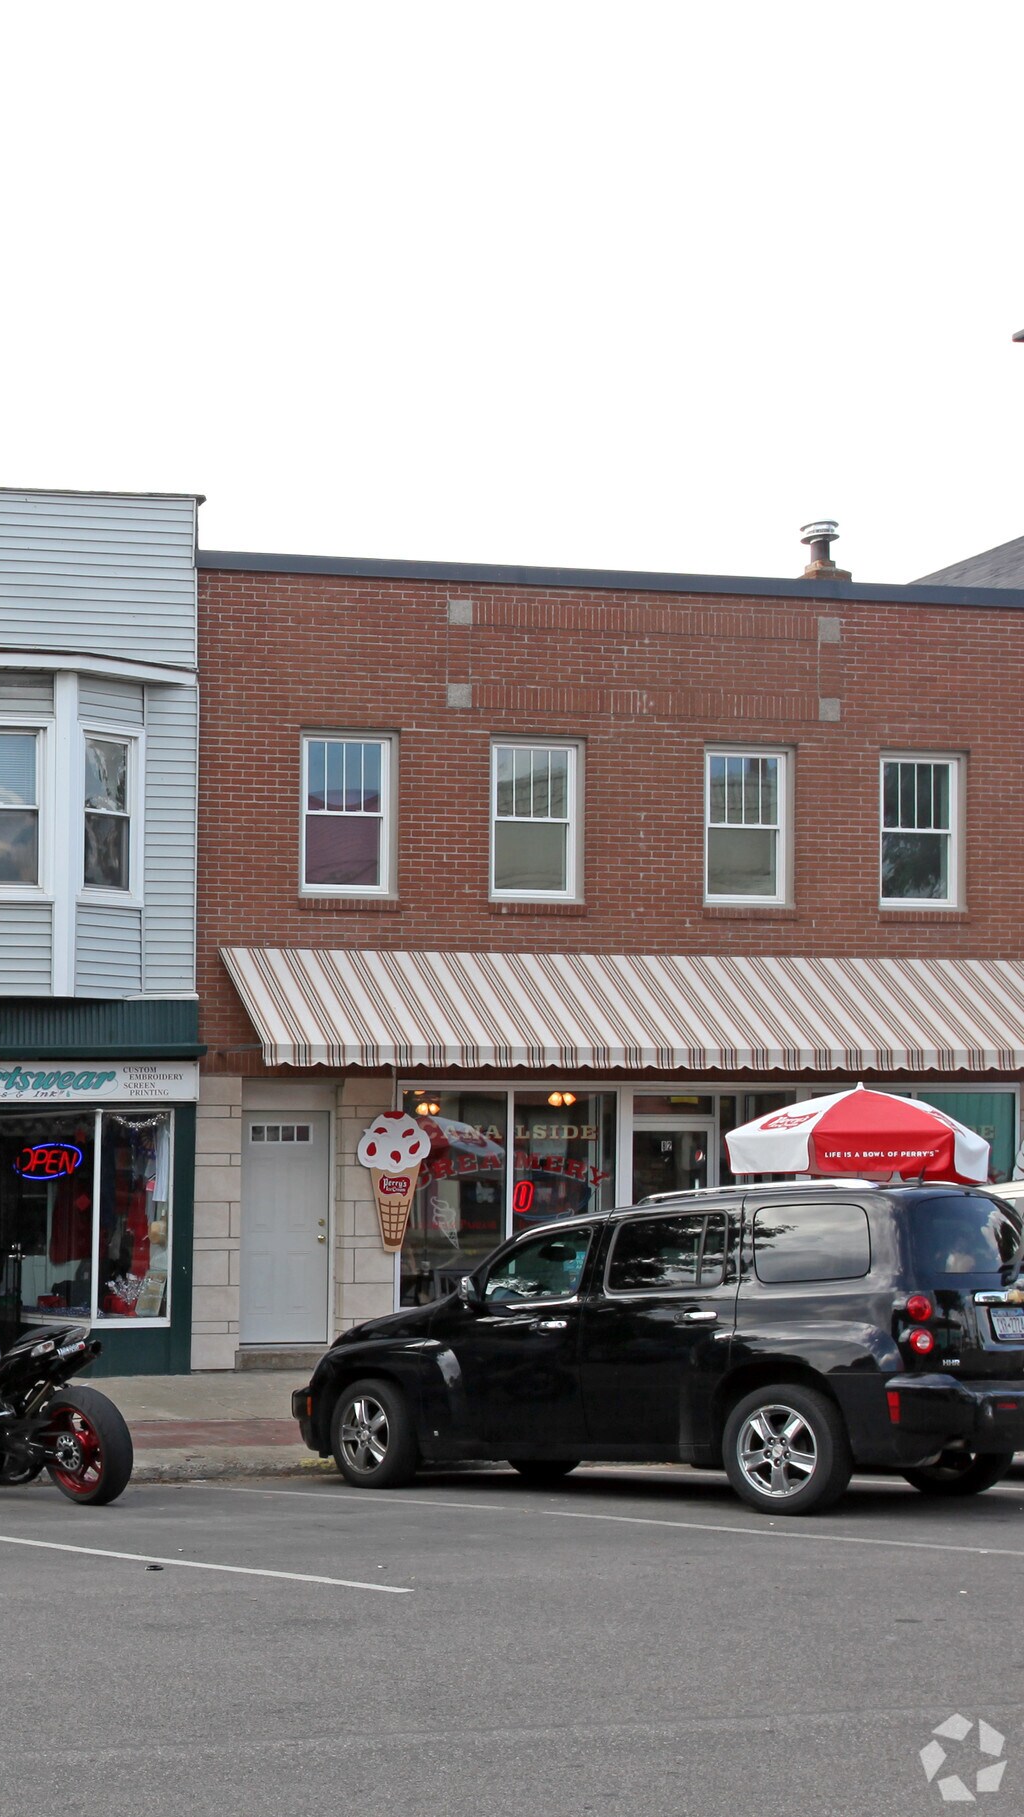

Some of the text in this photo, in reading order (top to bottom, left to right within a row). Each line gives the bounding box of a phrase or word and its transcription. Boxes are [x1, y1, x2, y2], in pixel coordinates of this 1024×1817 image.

[122, 1066, 157, 1074] CUSTOM
[129, 1073, 184, 1081] EMBROIDERY
[15, 1090, 24, 1098] &
[129, 1088, 169, 1097] PRINTING
[862, 1150, 885, 1158] BOWL
[887, 1150, 898, 1158] OF
[16, 1147, 78, 1174] OPEN
[383, 1178, 407, 1189] Perry's
[942, 1359, 961, 1367] HHR
